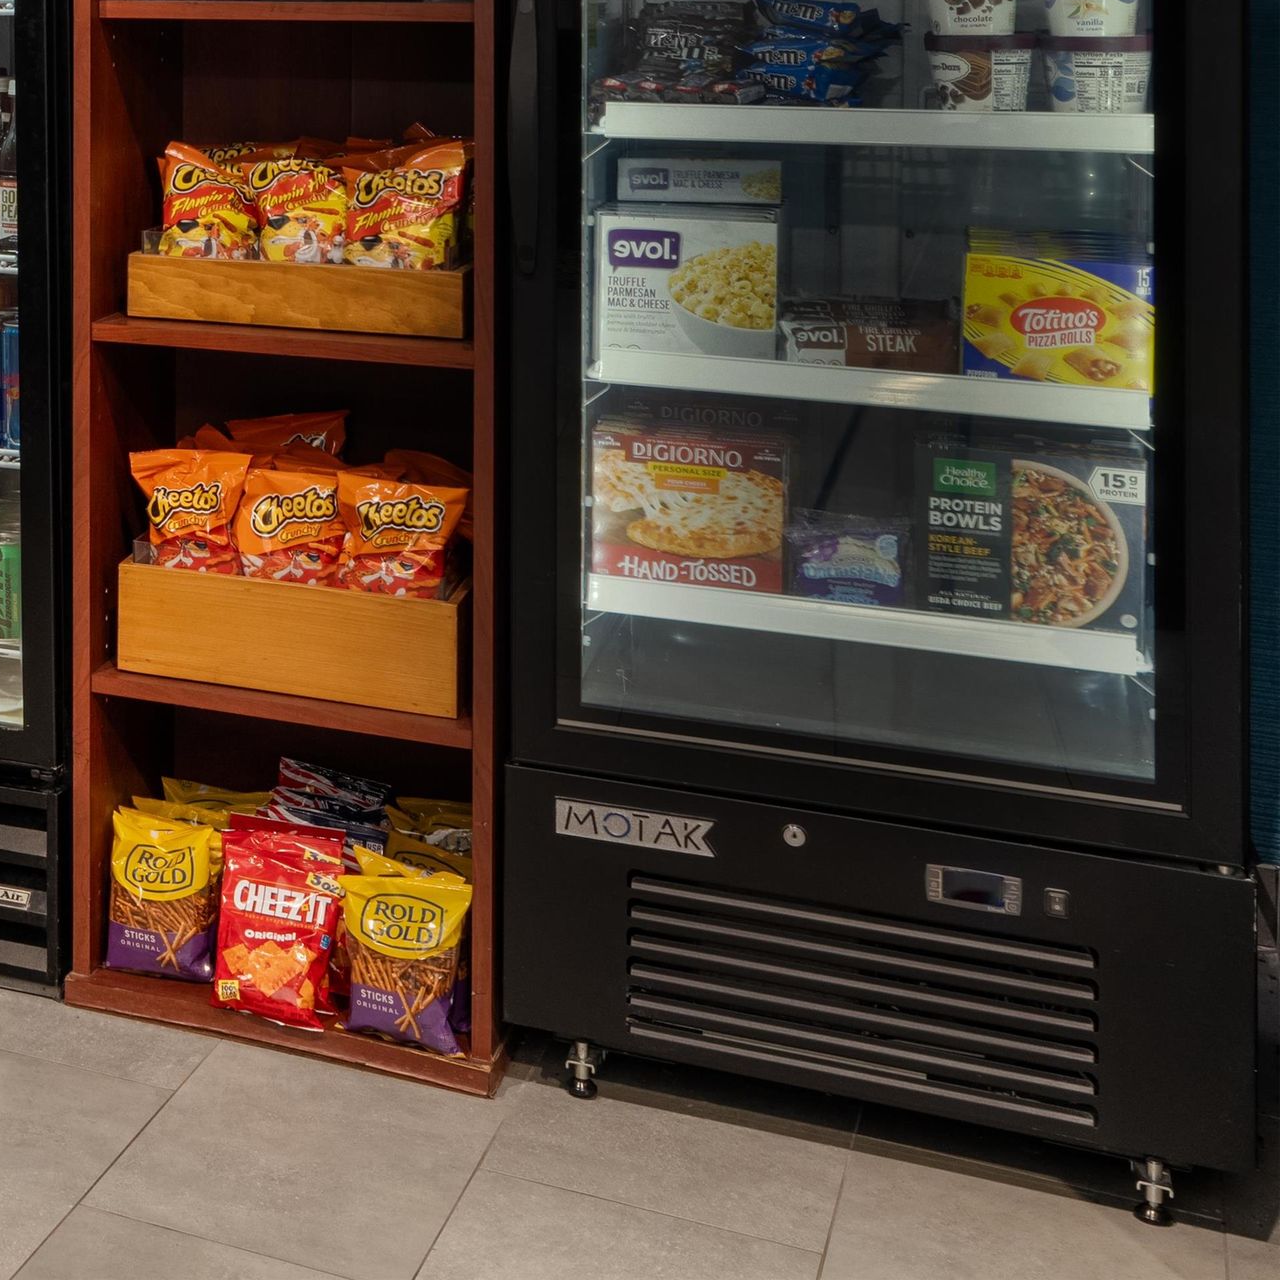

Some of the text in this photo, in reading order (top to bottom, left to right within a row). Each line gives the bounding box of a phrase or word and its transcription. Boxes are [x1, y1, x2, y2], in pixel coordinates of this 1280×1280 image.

[953, 15, 993, 23] chocolate
[1076, 19, 1104, 27] vanilla
[703, 170, 739, 180] PARMESAN
[697, 180, 724, 189] CHEESE
[259, 182, 311, 210] Flamin'
[607, 276, 646, 287] TRUFFLE
[1136, 269, 1150, 288] 15
[607, 287, 656, 298] PARMESAN
[607, 297, 670, 310] MAC & CHEESE
[1019, 308, 1099, 332] Totino's
[867, 334, 918, 353] STEAK
[1027, 332, 1092, 347] PIZZA ROLLS
[632, 442, 743, 468] DIGIORNO
[653, 464, 721, 477] PERSONAL SIZE
[944, 465, 987, 479] Healthy
[940, 475, 990, 488] Choice
[1100, 473, 1126, 488] 15
[1099, 490, 1138, 499] PROTEIN
[147, 481, 221, 529] Cheetos
[251, 485, 338, 537] Cheetos
[929, 497, 1003, 515] PROTEIN
[166, 513, 208, 532] Crunchy
[356, 496, 446, 541] Cheetos
[929, 510, 1002, 531] BOWLS
[277, 524, 321, 544] Crunchy
[928, 534, 977, 546] KOREAN-
[928, 543, 991, 557] STYLE BEEF
[617, 555, 757, 588] HAND-TOSSED
[564, 804, 703, 852] MOTAK
[137, 848, 186, 870] ROLD
[131, 865, 187, 885] GOLD
[373, 900, 437, 924] ROLD
[124, 929, 156, 943] STICKS
[370, 920, 434, 945] GOLD
[120, 938, 161, 953] ORIGINAL
[360, 988, 395, 1005] STICKS
[356, 999, 399, 1016] ORIGINAL
